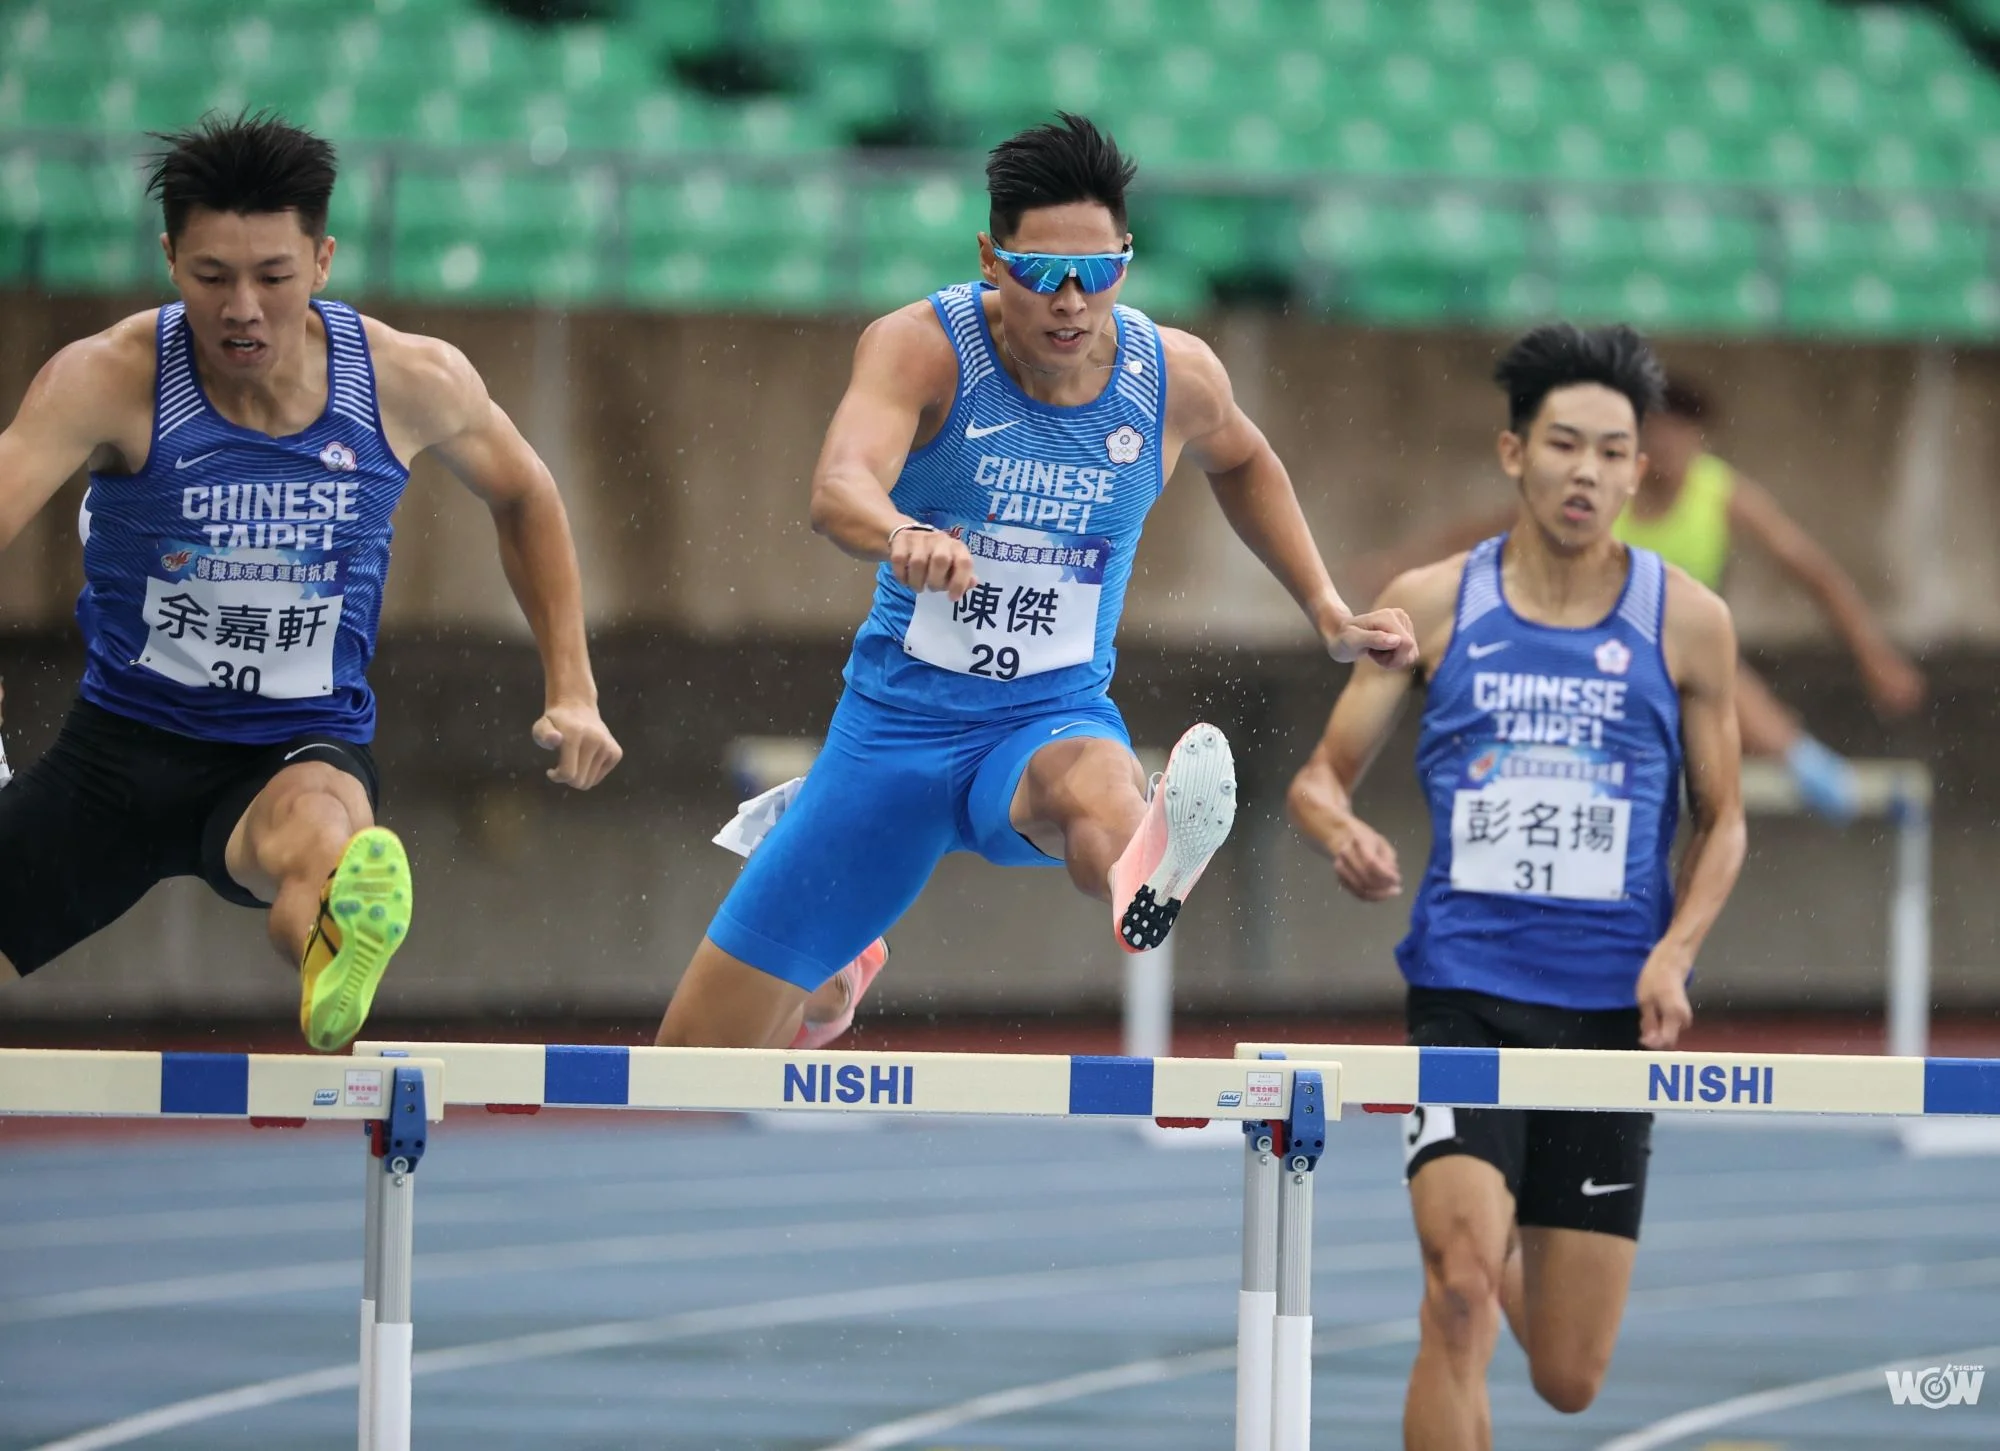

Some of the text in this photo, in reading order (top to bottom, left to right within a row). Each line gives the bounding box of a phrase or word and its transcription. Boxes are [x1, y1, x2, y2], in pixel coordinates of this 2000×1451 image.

[974, 455, 1117, 503] CHINESE
[181, 482, 360, 521] CHINESE
[986, 490, 1092, 535] TAIPEI
[156, 592, 329, 654] 余嘉軒
[952, 582, 1059, 636] 陳傑
[208, 660, 261, 695] 30
[968, 644, 1020, 680] 29
[1473, 672, 1629, 721] CHINESE
[1466, 798, 1616, 853] 彭名揚
[1513, 861, 1556, 892] 31
[784, 1064, 913, 1104] NISHI
[1649, 1064, 1773, 1104] NISHI
